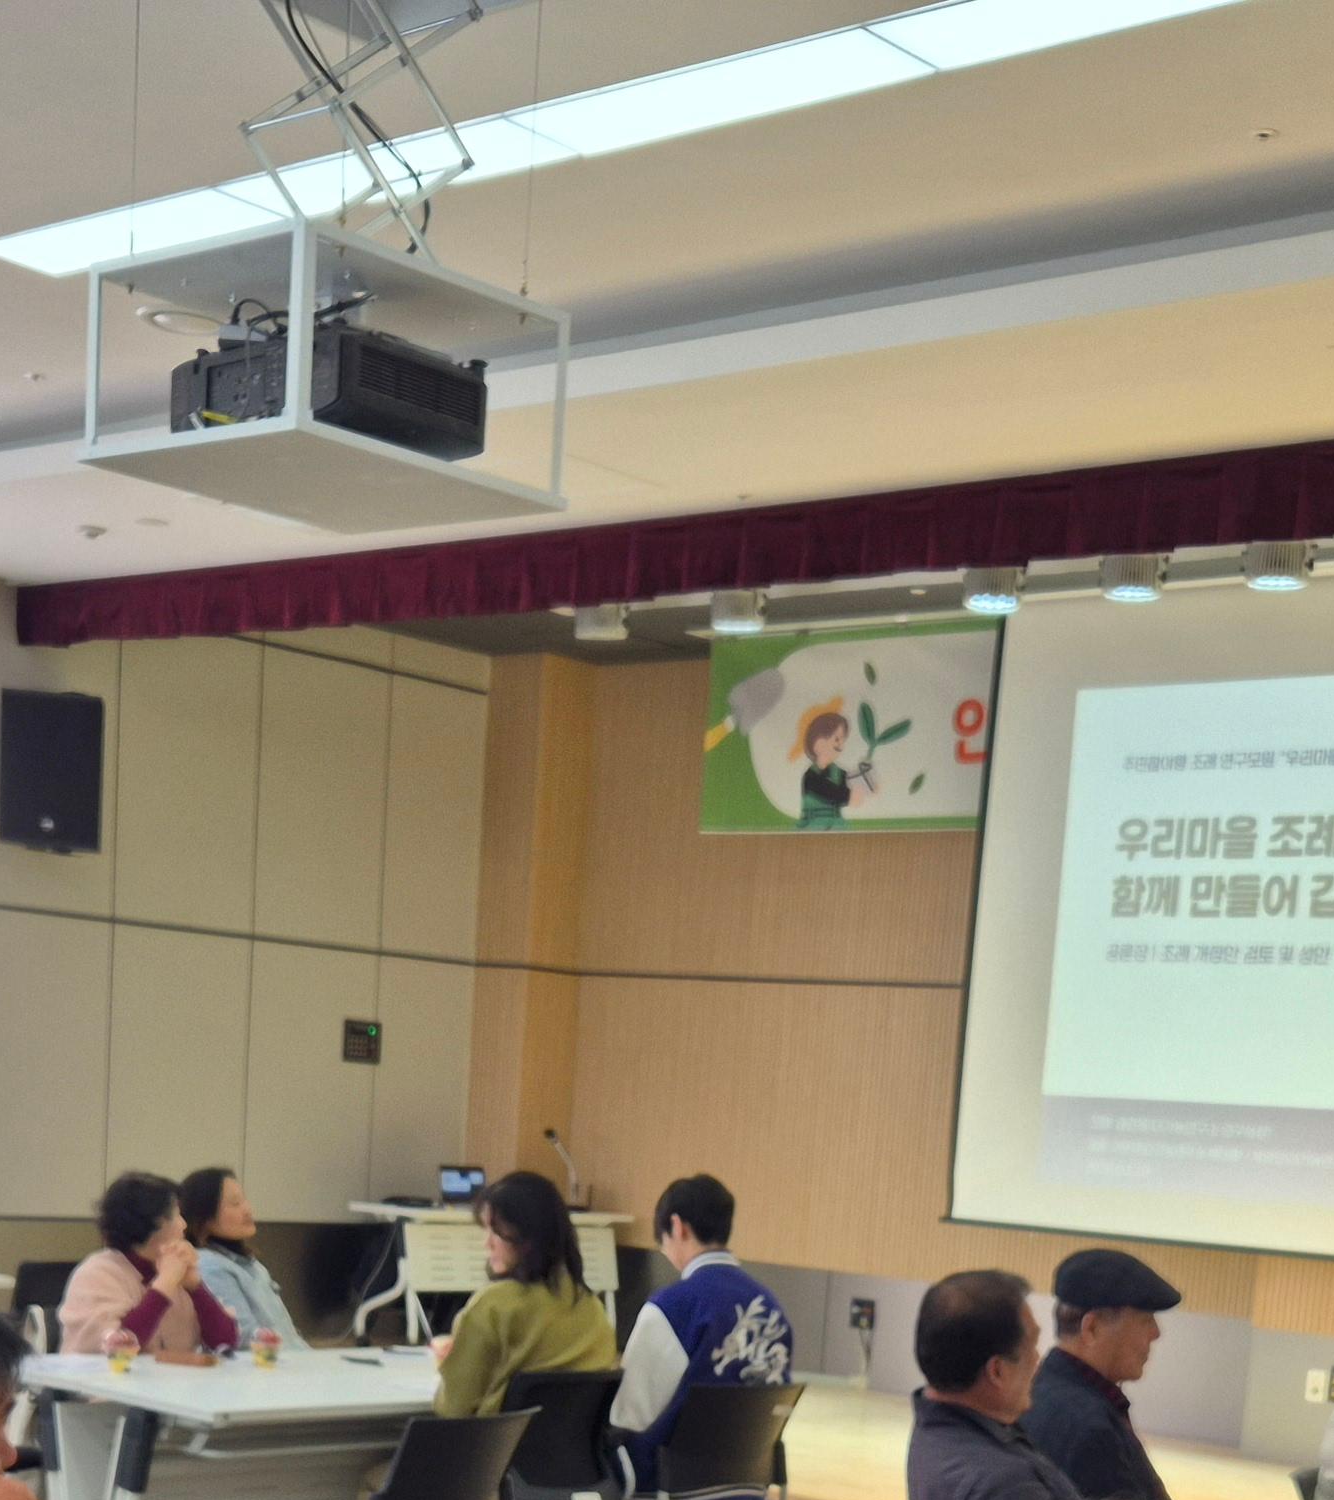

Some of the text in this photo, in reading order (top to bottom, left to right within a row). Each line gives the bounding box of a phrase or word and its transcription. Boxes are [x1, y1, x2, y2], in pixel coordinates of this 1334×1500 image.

[1115, 814, 1258, 861] 우리마을
[1111, 873, 1181, 918] 함께
[1188, 873, 1300, 918] 만들어
